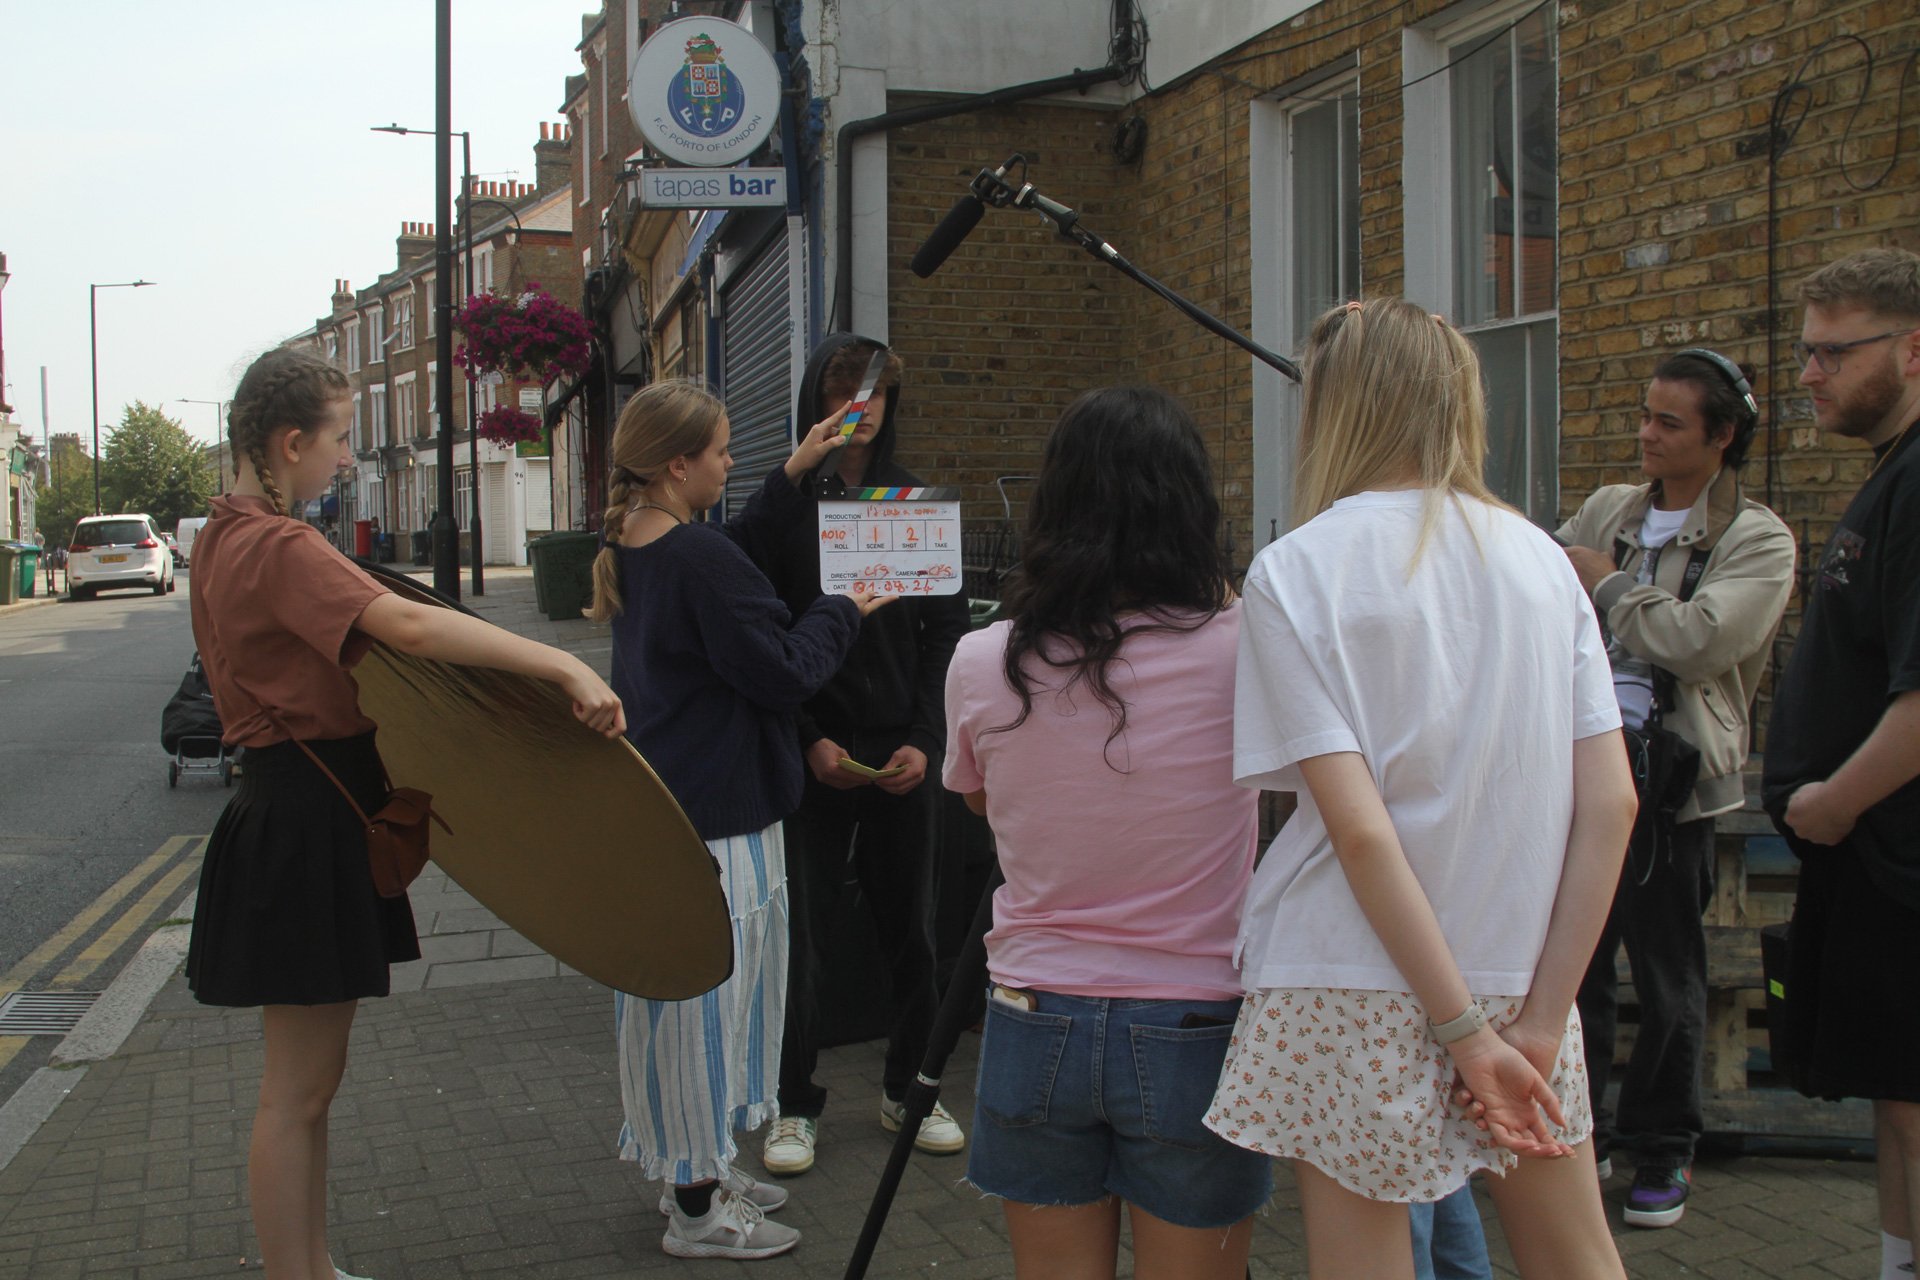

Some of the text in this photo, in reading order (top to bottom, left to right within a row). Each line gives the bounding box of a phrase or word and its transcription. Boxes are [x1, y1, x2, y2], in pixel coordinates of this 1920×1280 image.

[654, 114, 762, 152] F.C. PORTO OF LONDON
[654, 174, 776, 201] tapas bar
[906, 527, 919, 541] 2
